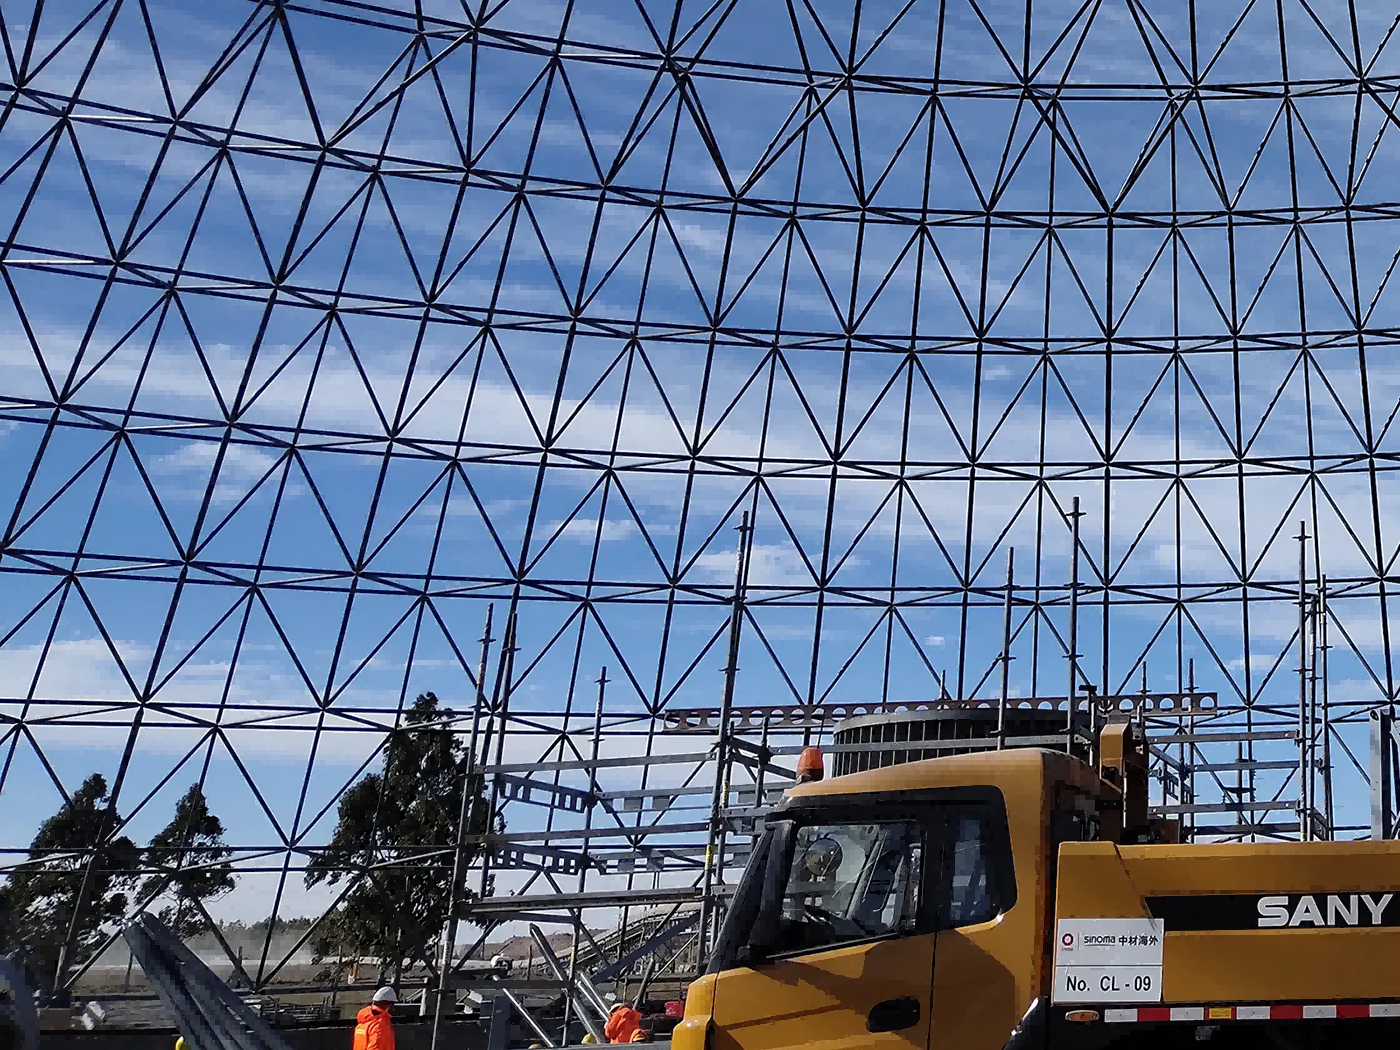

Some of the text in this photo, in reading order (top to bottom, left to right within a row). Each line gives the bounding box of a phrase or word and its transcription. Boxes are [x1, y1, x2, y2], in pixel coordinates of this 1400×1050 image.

[1257, 893, 1393, 927] SANY
[1084, 935, 1159, 946] sinoma 中材海外
[1066, 975, 1090, 992] No.
[1100, 975, 1120, 991] CL
[1134, 975, 1151, 991] 09
